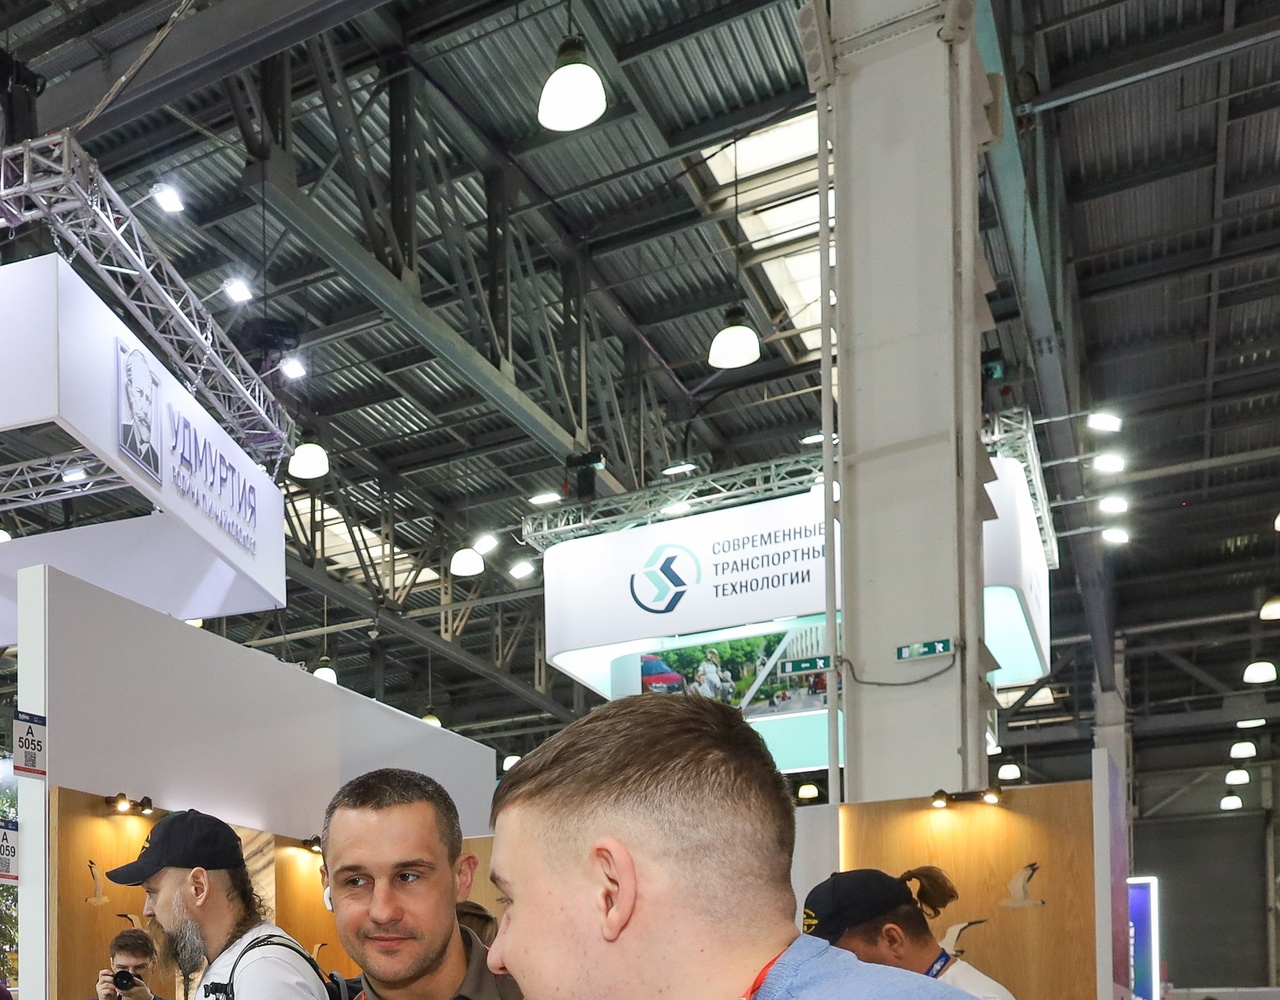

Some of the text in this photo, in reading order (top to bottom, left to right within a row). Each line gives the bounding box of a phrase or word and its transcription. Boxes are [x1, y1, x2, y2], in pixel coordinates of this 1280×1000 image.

[166, 402, 258, 529] УДМУРТИЯ
[712, 521, 826, 555] СОВРЕМЕННЫЕ
[712, 544, 826, 577] ТРАНСПОРТНЫ
[713, 569, 812, 598] ТЕХНОЛОГИИ
[18, 736, 43, 752] 5055
